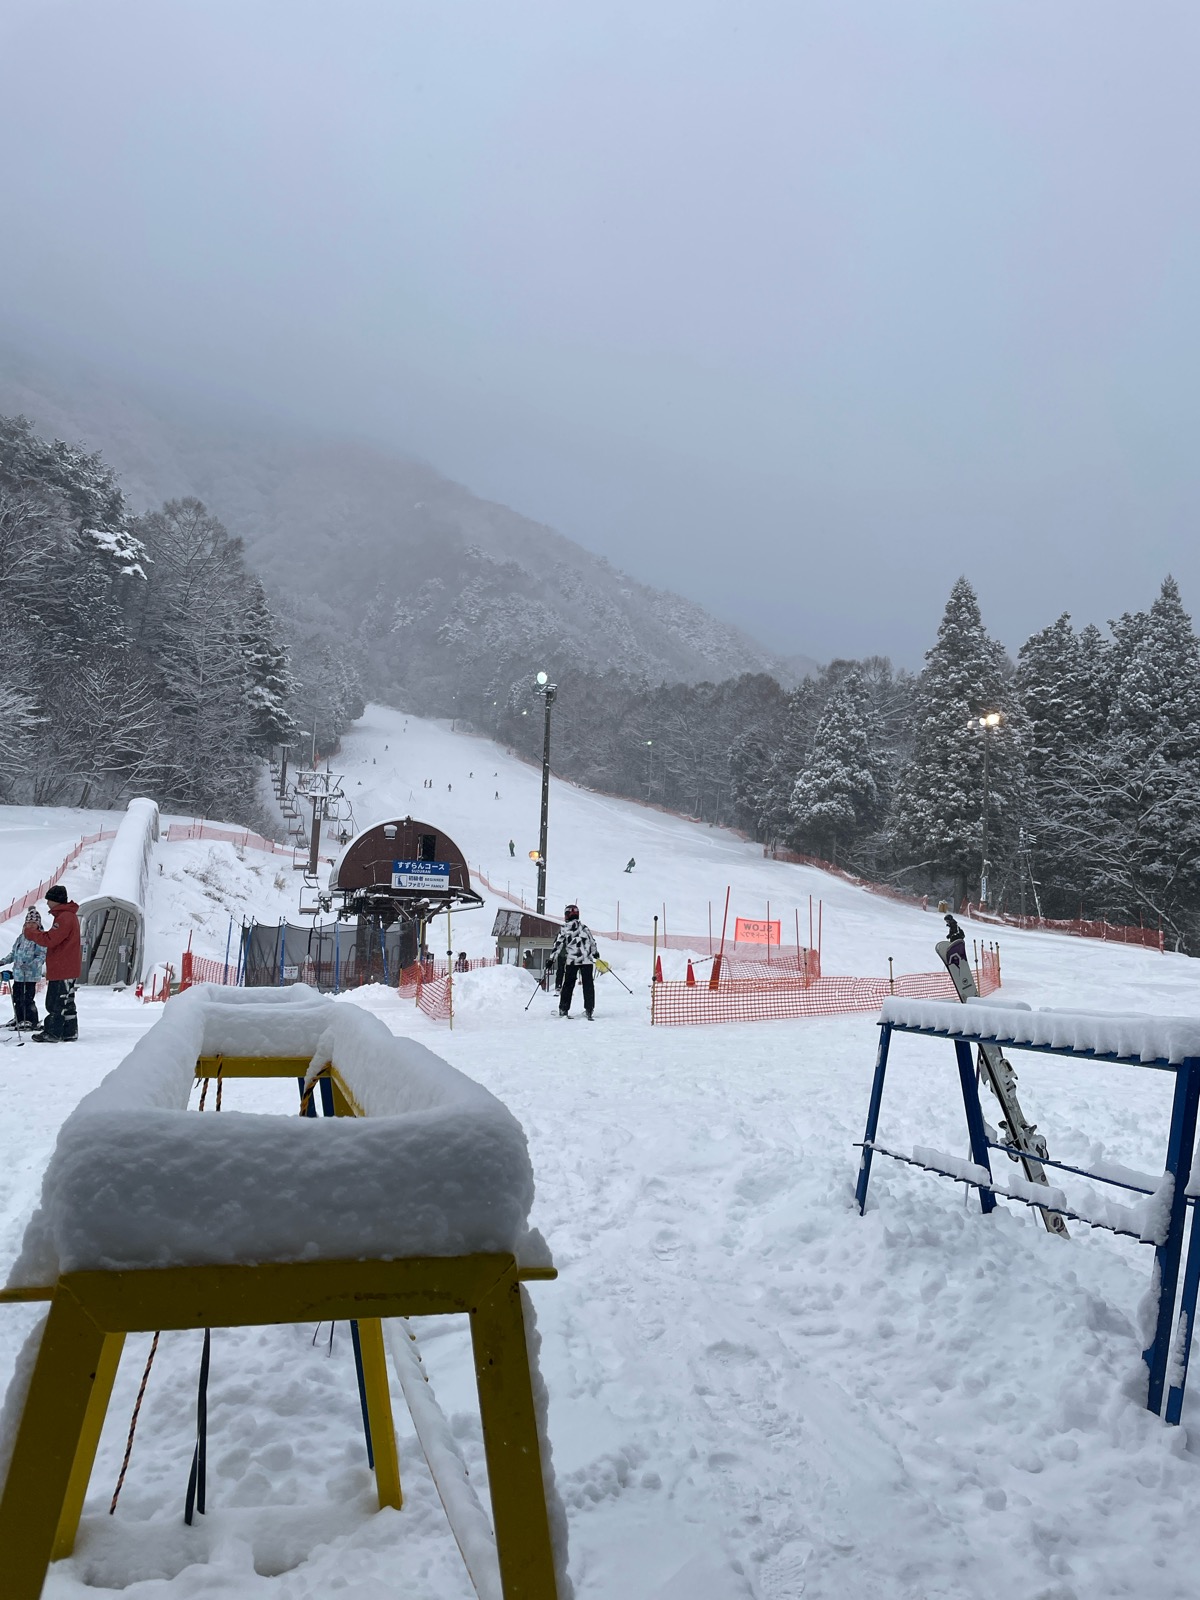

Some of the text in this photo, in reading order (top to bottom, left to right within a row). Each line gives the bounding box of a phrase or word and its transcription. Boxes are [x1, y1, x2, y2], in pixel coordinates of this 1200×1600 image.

[397, 862, 445, 870] すずらんコース
